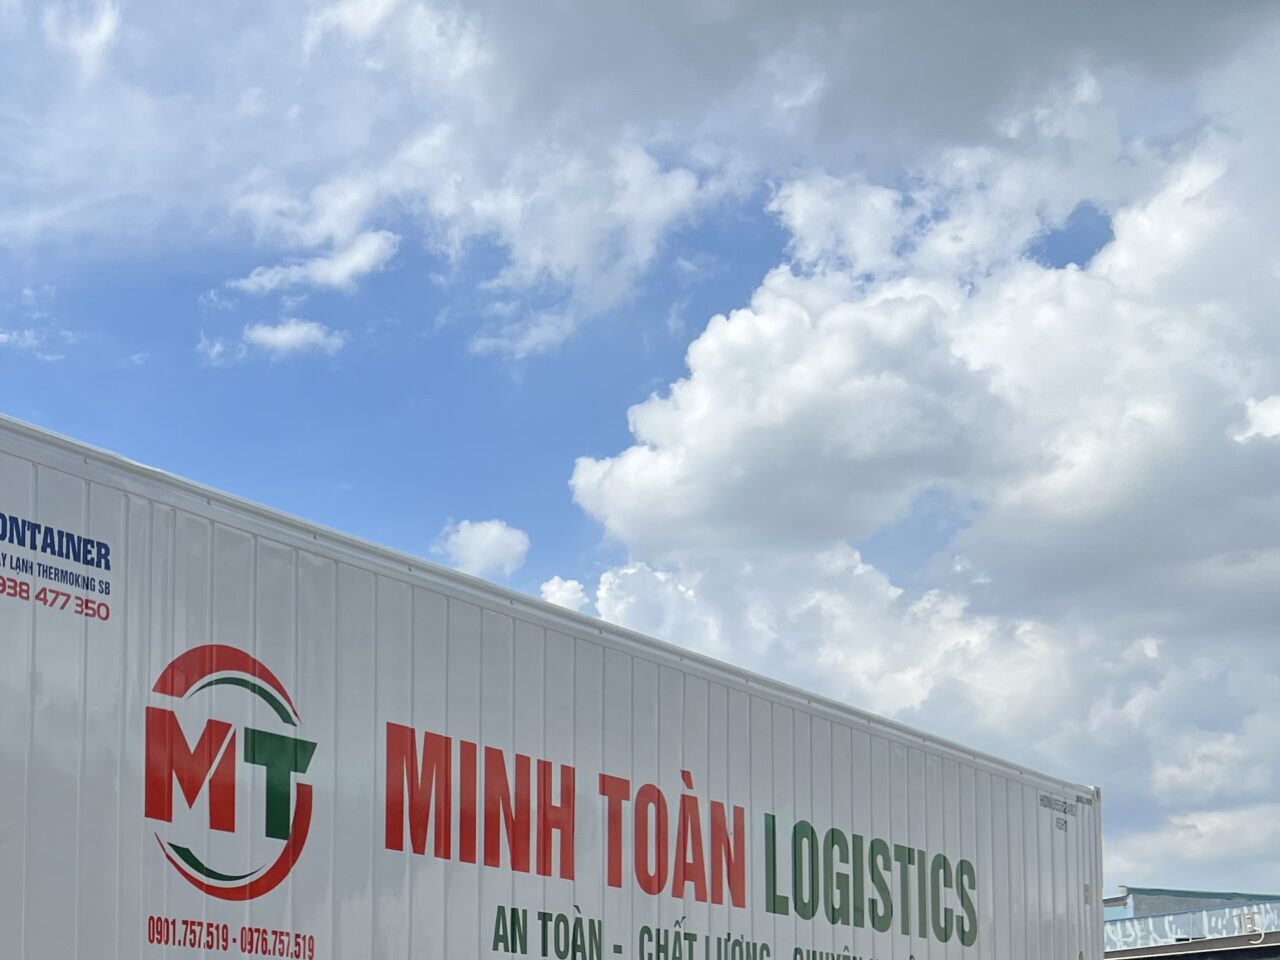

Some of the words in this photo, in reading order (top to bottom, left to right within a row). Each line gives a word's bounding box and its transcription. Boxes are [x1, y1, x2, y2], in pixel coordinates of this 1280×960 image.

[10, 555, 34, 576] LẠNH
[36, 562, 96, 592] THERMOKING
[98, 579, 111, 596] SB
[34, 587, 72, 611] 477
[74, 596, 110, 622] 350
[144, 706, 318, 841] MT
[385, 721, 576, 881] MINH
[598, 769, 746, 909] TOÀN
[764, 812, 978, 948] LOGISTICS
[148, 915, 229, 952] 0901.757.519
[240, 926, 314, 960] 0976.757.519
[492, 905, 528, 955] AN
[613, 944, 623, 955] -
